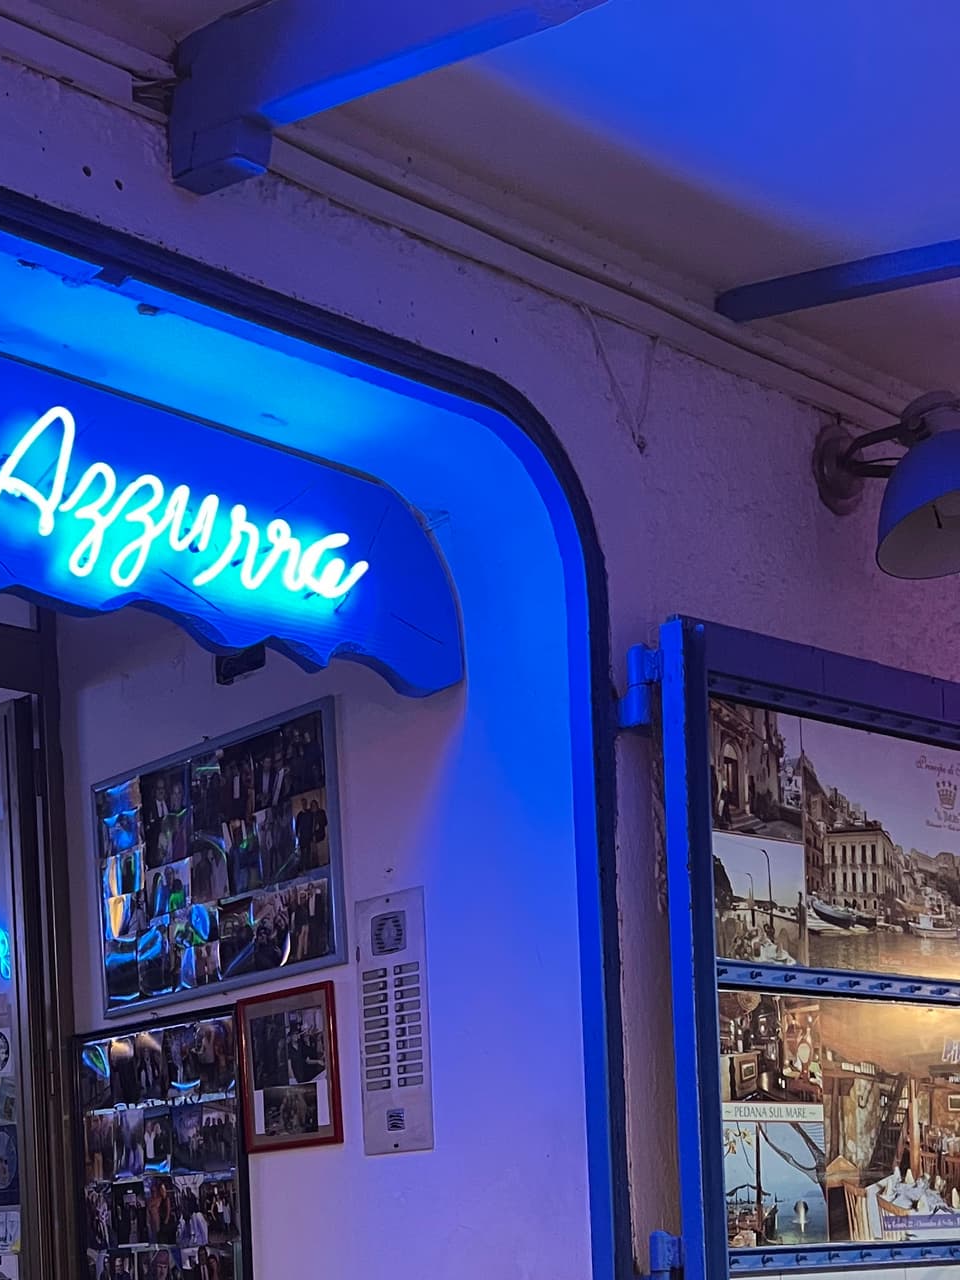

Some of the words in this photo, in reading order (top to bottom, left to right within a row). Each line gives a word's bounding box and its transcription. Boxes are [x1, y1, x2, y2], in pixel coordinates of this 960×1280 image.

[734, 1106, 767, 1118] PEDANA
[769, 1107, 783, 1118] SUL
[785, 1107, 807, 1119] MARE
